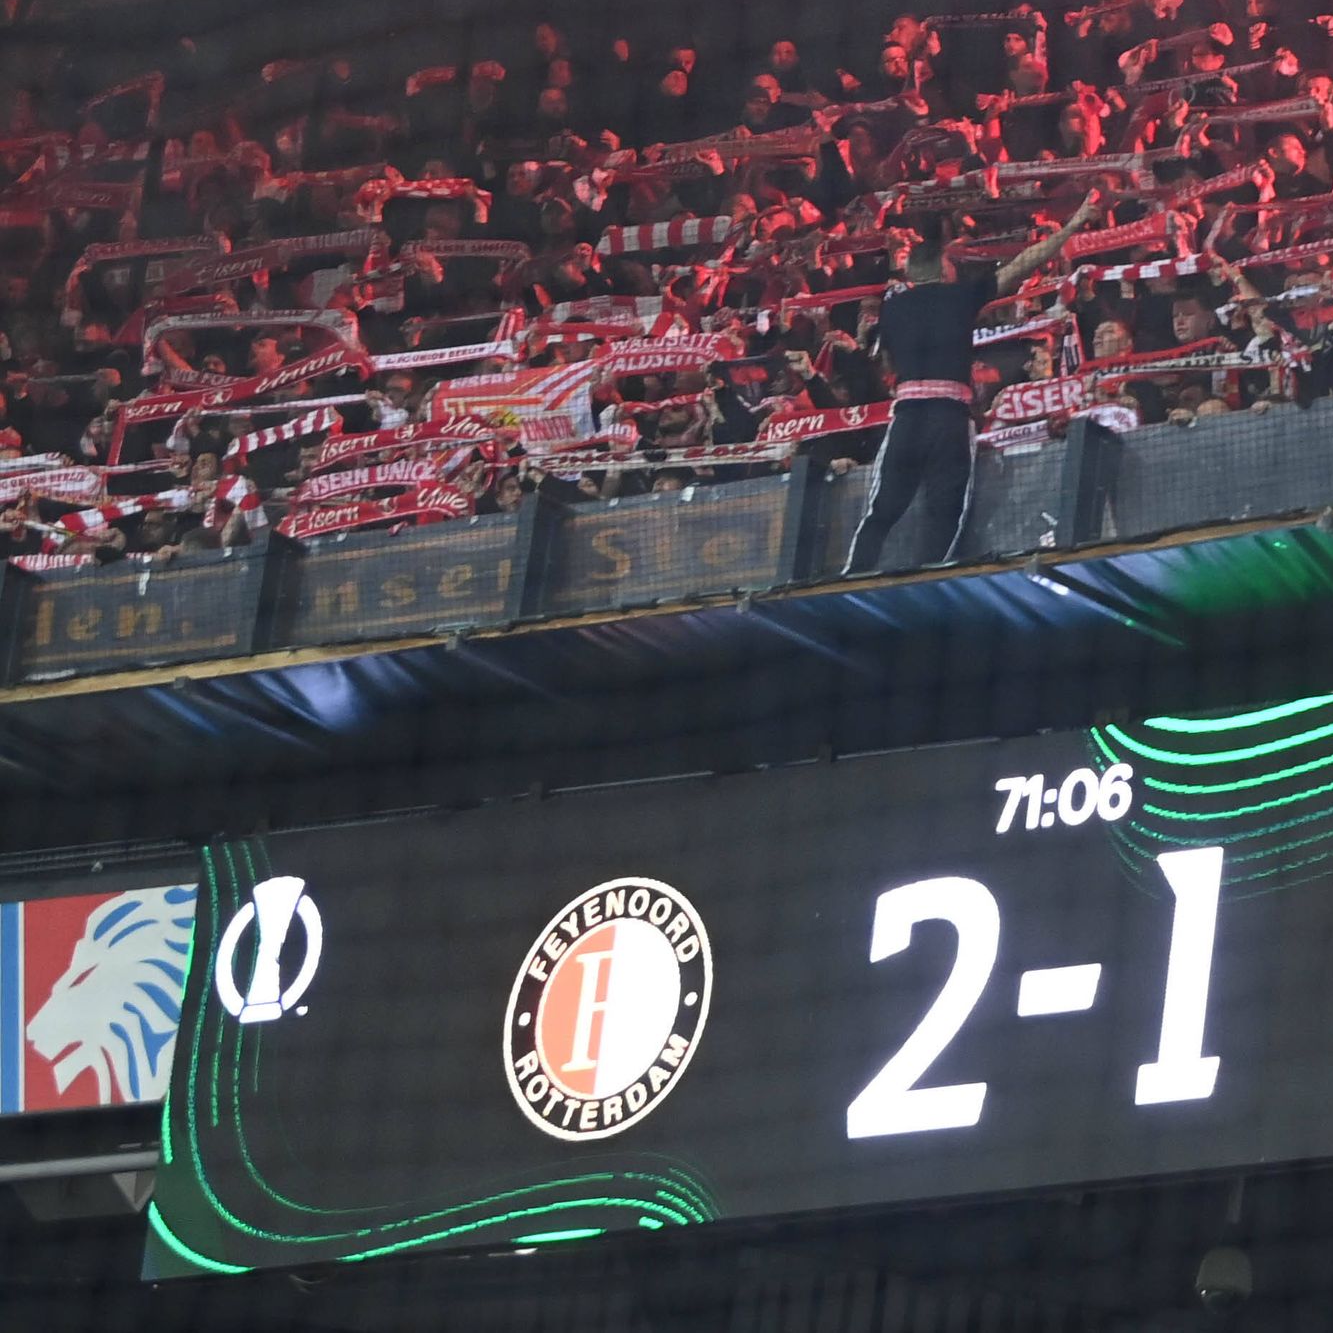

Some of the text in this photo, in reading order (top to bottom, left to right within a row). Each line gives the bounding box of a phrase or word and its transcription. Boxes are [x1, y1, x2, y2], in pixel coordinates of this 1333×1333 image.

[611, 333, 722, 351] WALDSEITE
[125, 399, 184, 418] sern
[254, 350, 345, 395] Union
[996, 378, 1083, 420] EISER
[320, 432, 379, 463] isern
[767, 412, 825, 442] isern
[995, 762, 1134, 835] 71:06
[527, 888, 701, 983] FEYENOORD
[514, 1033, 690, 1131] ROTTERDAM
